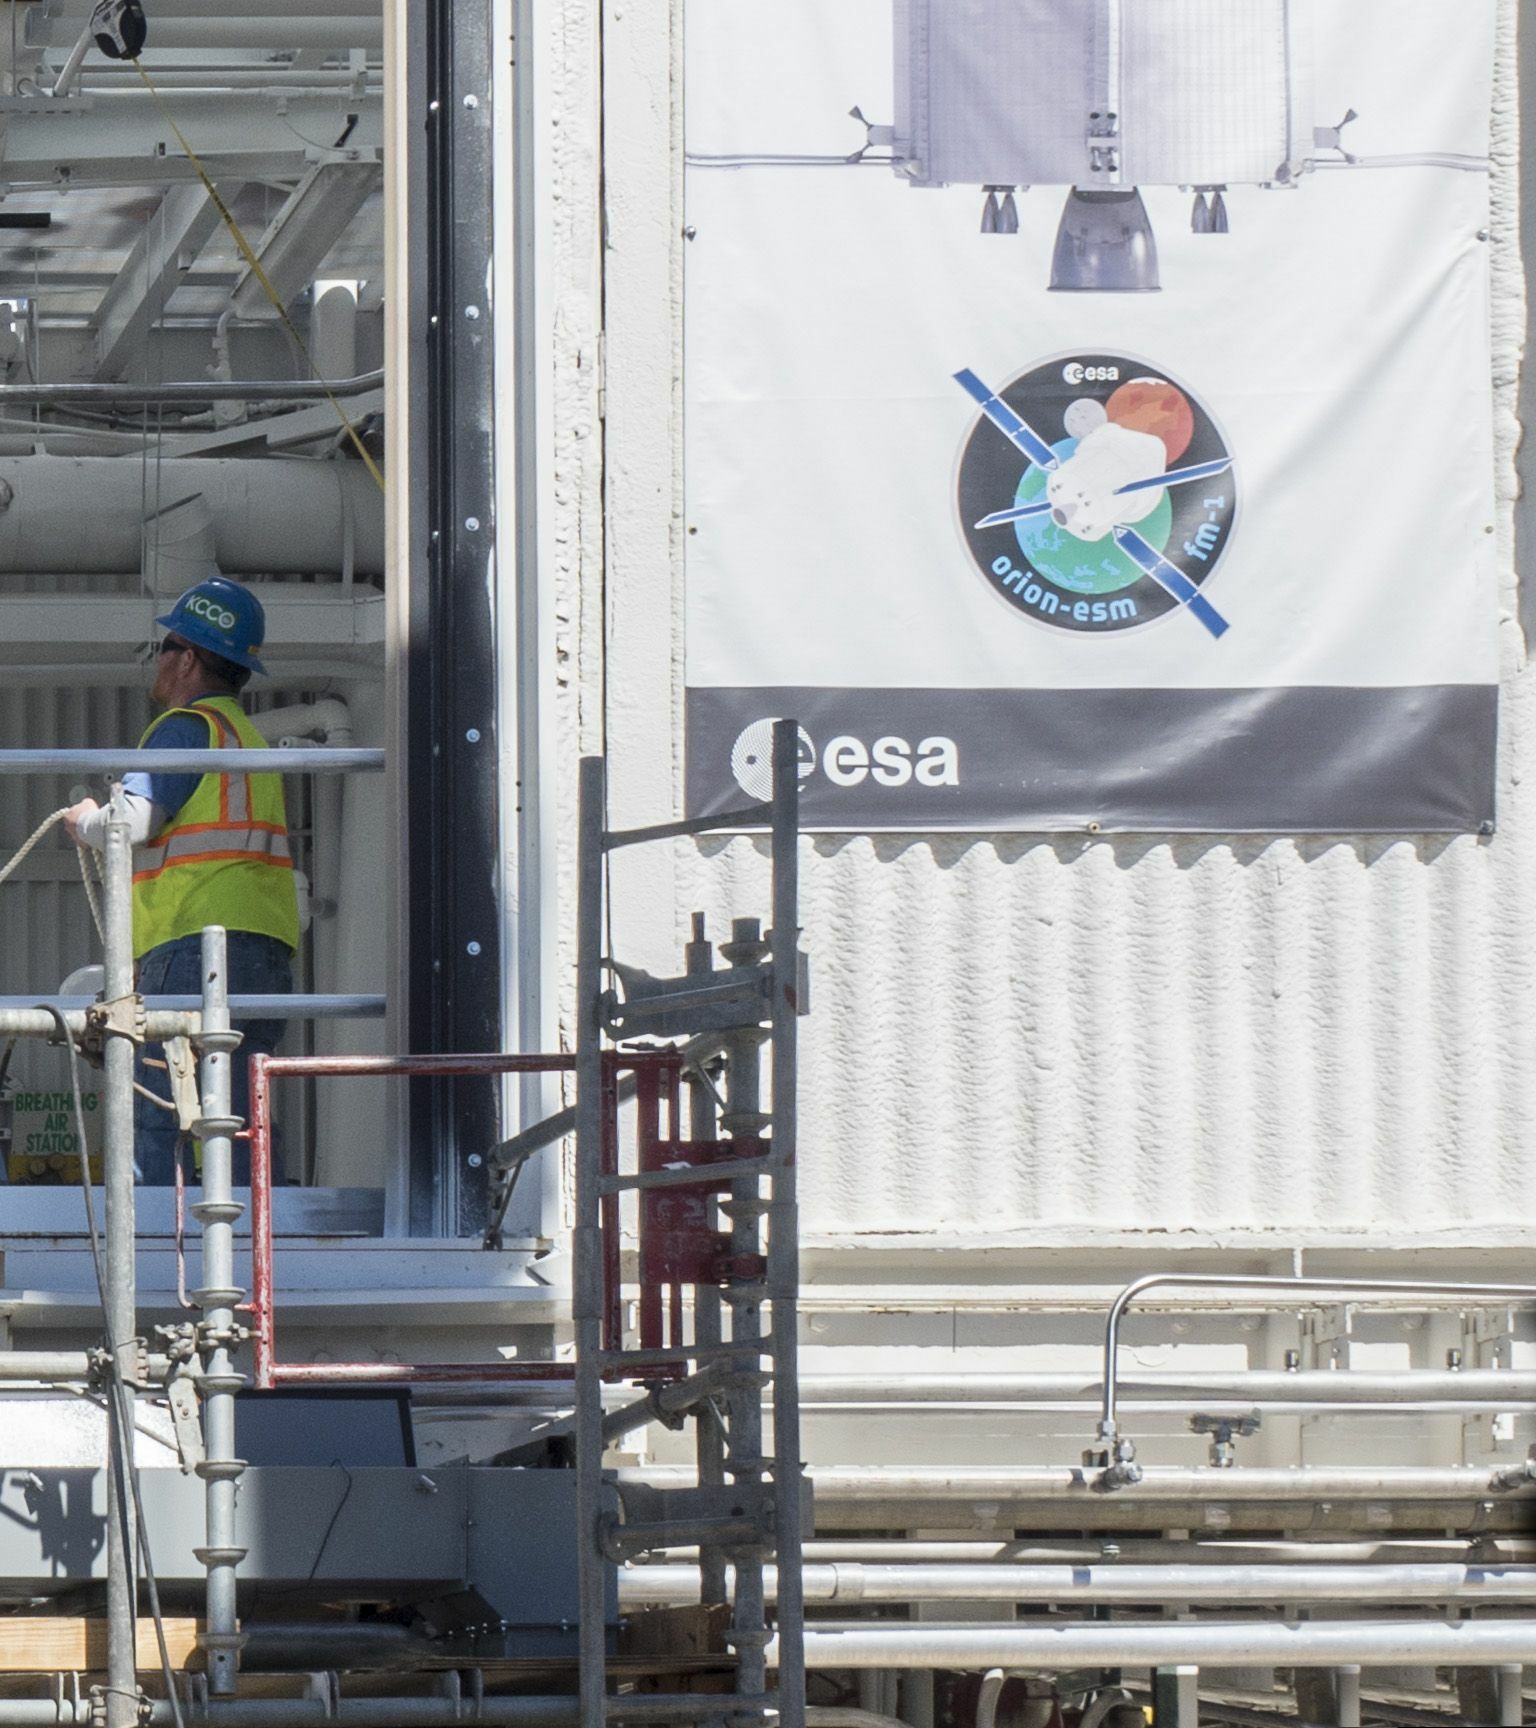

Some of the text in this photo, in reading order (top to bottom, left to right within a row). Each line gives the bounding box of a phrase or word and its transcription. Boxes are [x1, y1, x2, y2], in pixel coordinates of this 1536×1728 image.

[1183, 495, 1225, 561] fm-1
[185, 595, 235, 629] KCCO
[991, 554, 1138, 623] orion-esm
[823, 735, 960, 787] esa
[44, 1113, 69, 1133] AIR
